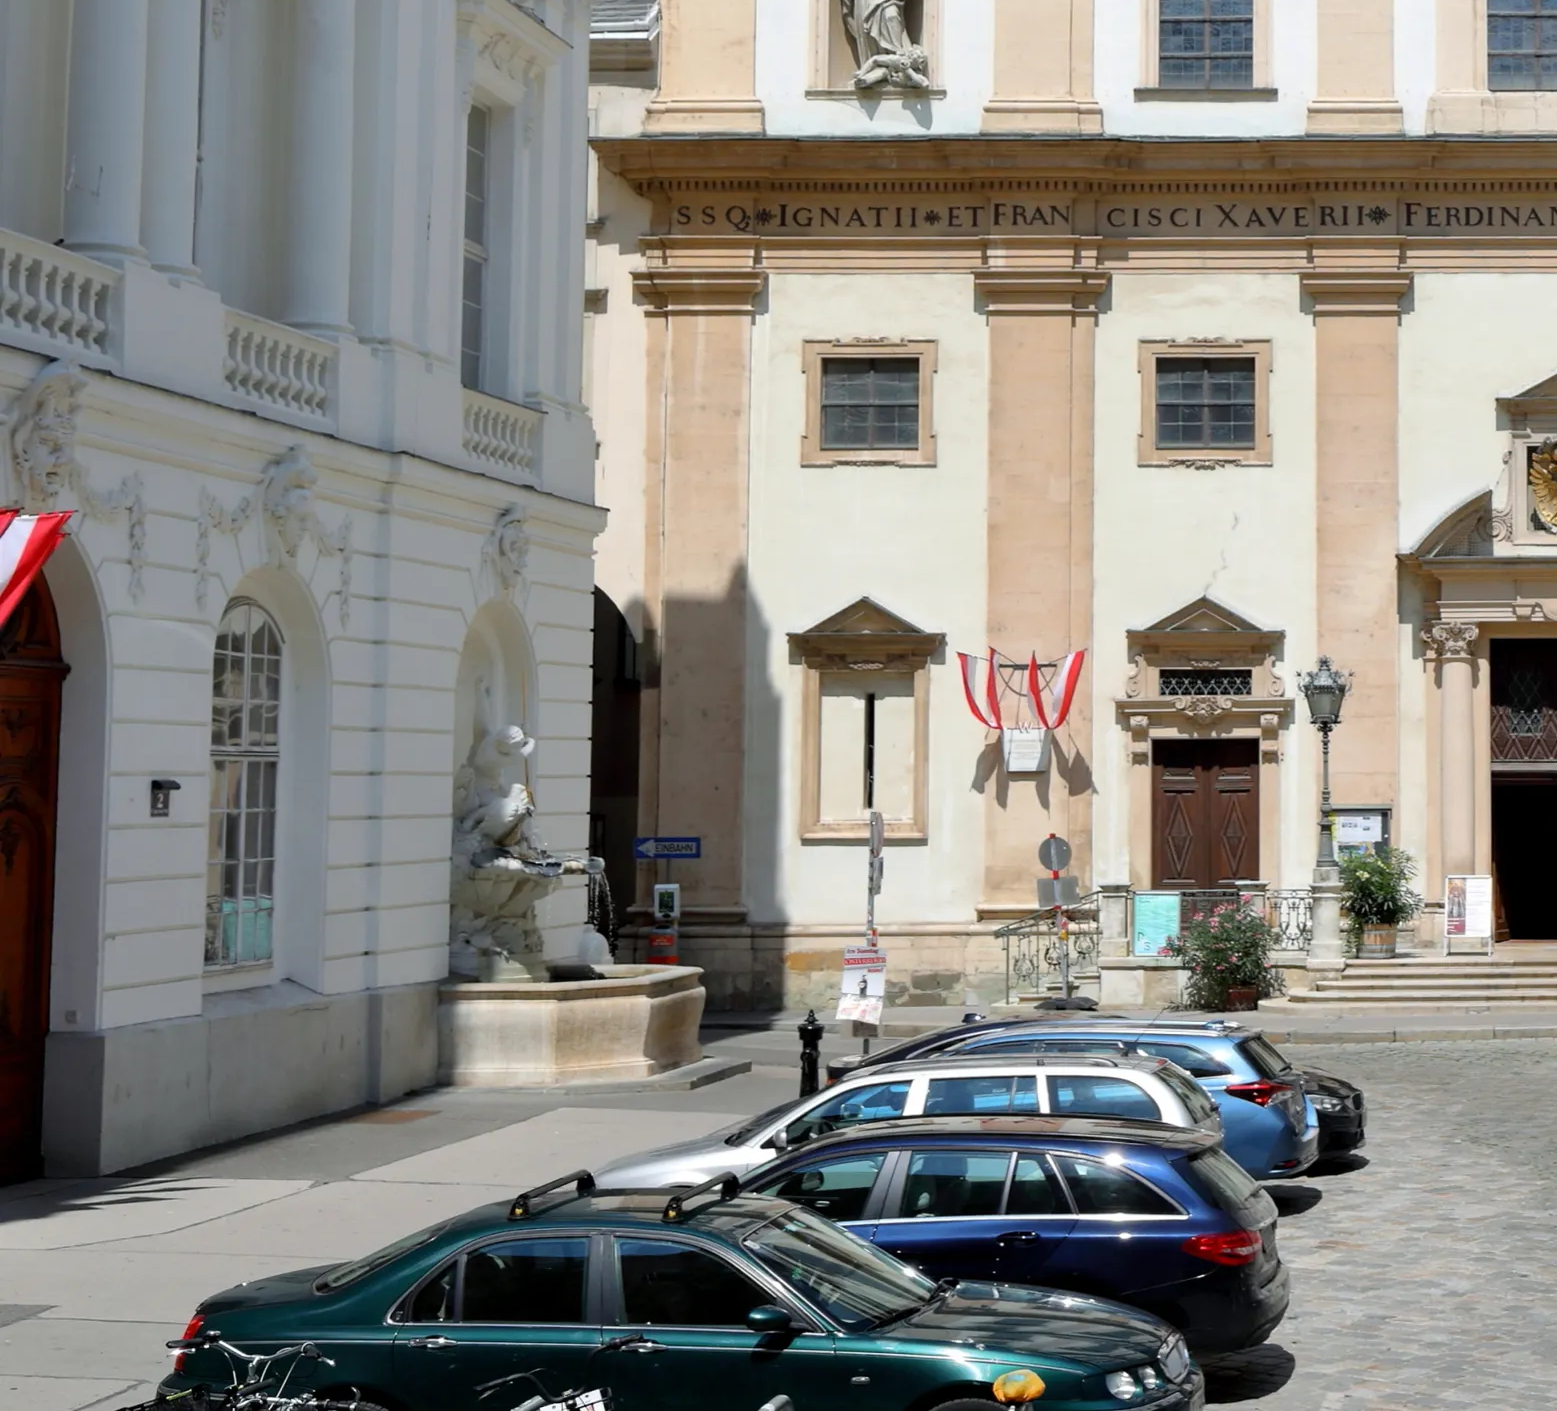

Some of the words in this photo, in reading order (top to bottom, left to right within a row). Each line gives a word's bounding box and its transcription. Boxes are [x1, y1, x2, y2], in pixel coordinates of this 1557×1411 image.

[777, 203, 917, 228] IGNATII
[947, 205, 986, 228] ET
[156, 792, 165, 809] 2
[655, 843, 694, 853] EINBAHN
